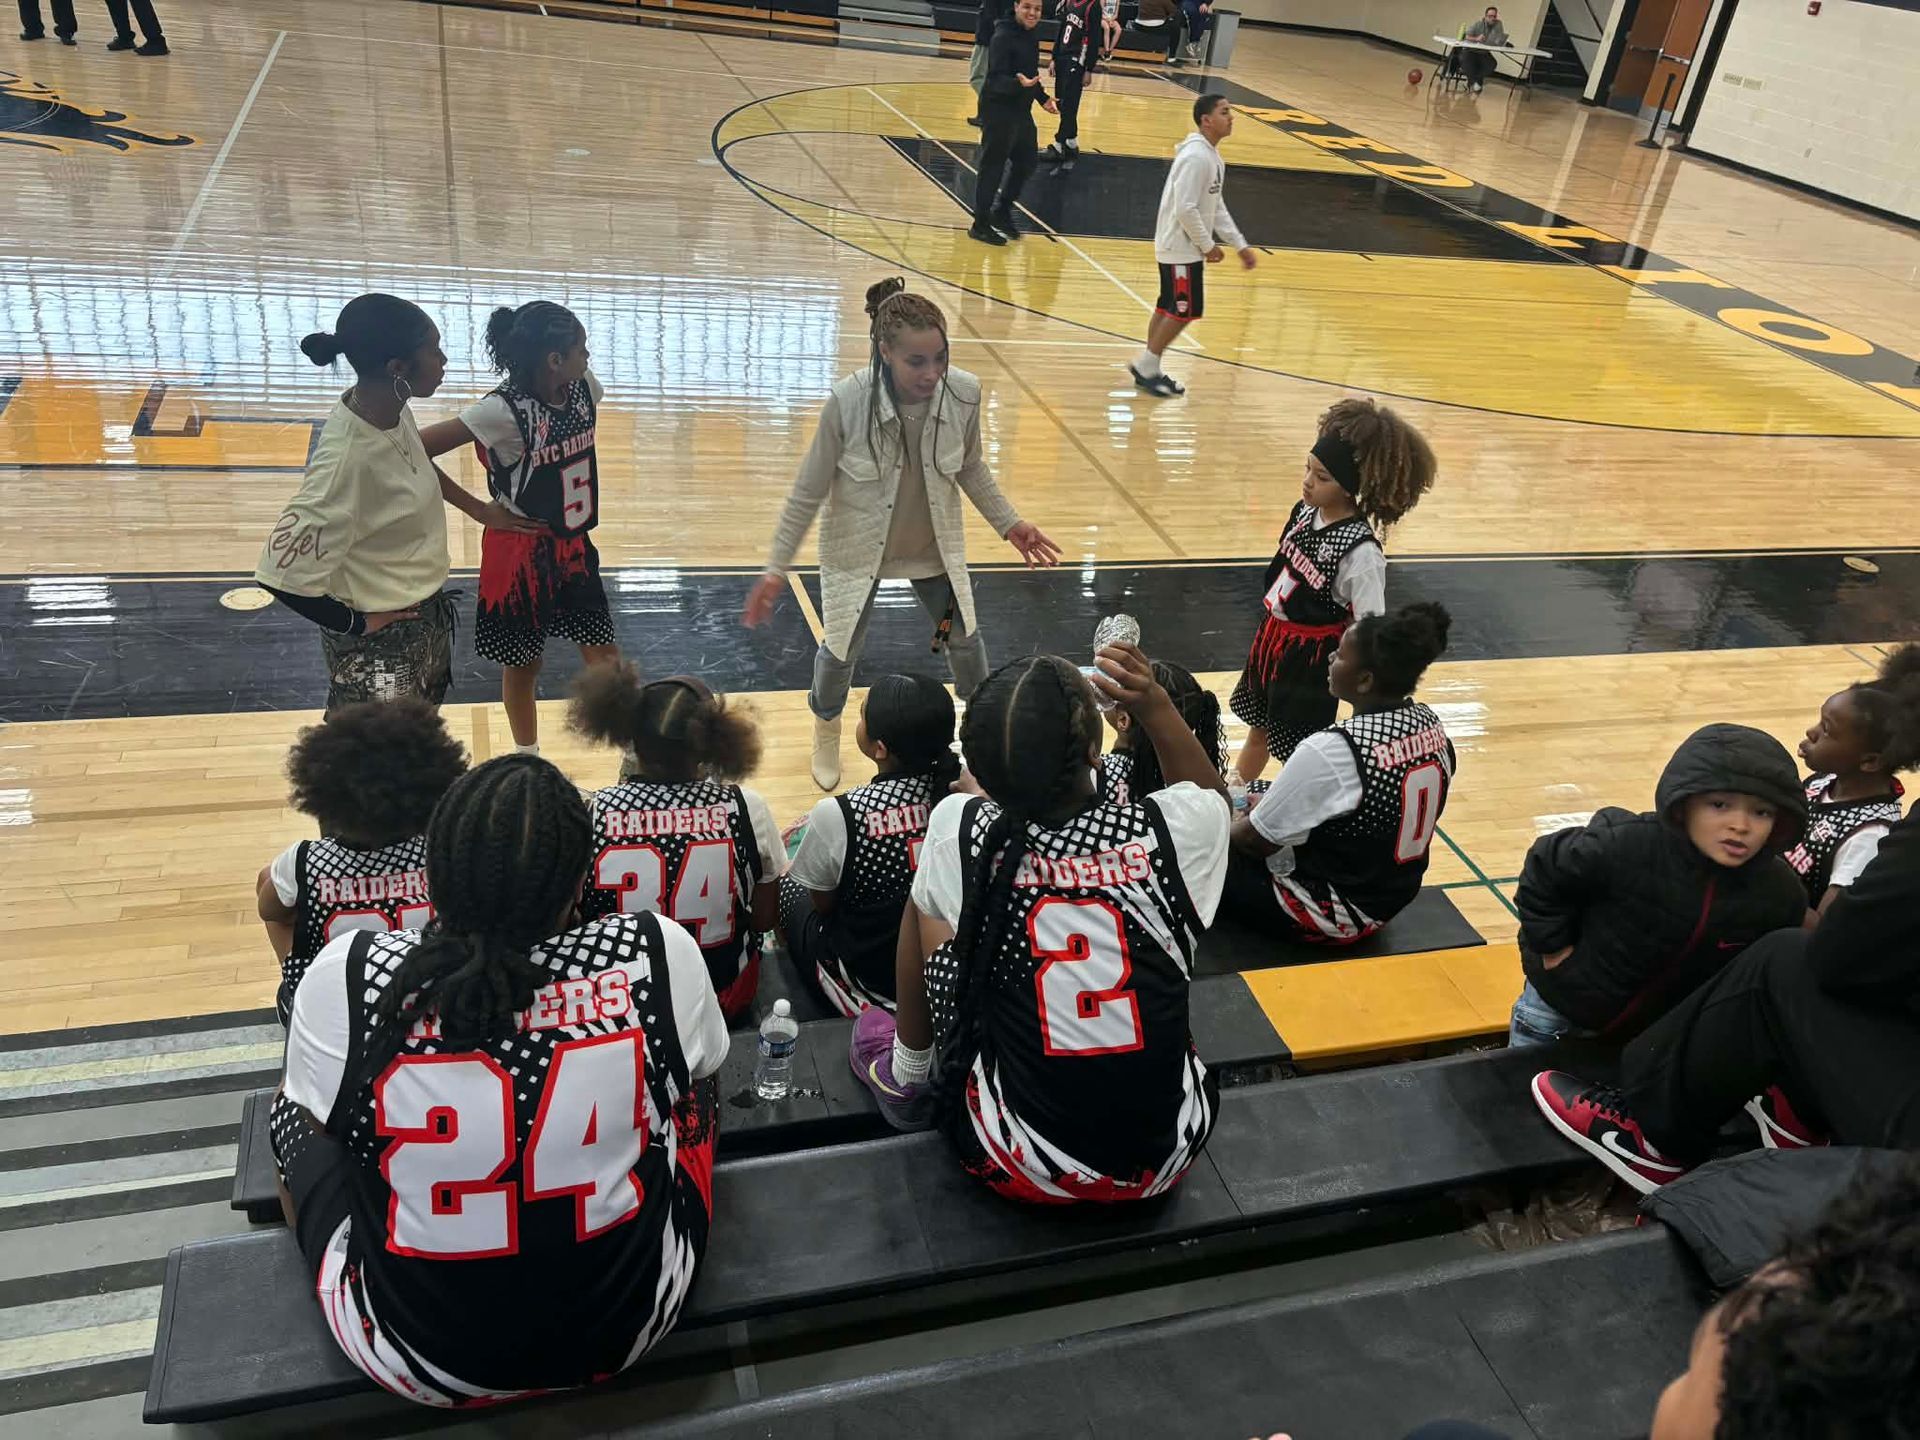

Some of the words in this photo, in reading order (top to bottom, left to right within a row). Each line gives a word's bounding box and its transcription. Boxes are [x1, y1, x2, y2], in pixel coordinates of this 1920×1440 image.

[1230, 104, 1475, 188] RED
[1497, 221, 1920, 411] LIO
[561, 426, 596, 459] RAIDE
[560, 456, 593, 533] 5
[1374, 725, 1448, 769] RAIDERS
[605, 805, 728, 838] RAIDERS
[865, 802, 930, 839] RAID
[1395, 761, 1443, 864] 0
[594, 838, 738, 950] 34
[1013, 842, 1152, 889] AIDERS
[1026, 896, 1144, 1056] 2
[372, 1026, 650, 1262] 24
